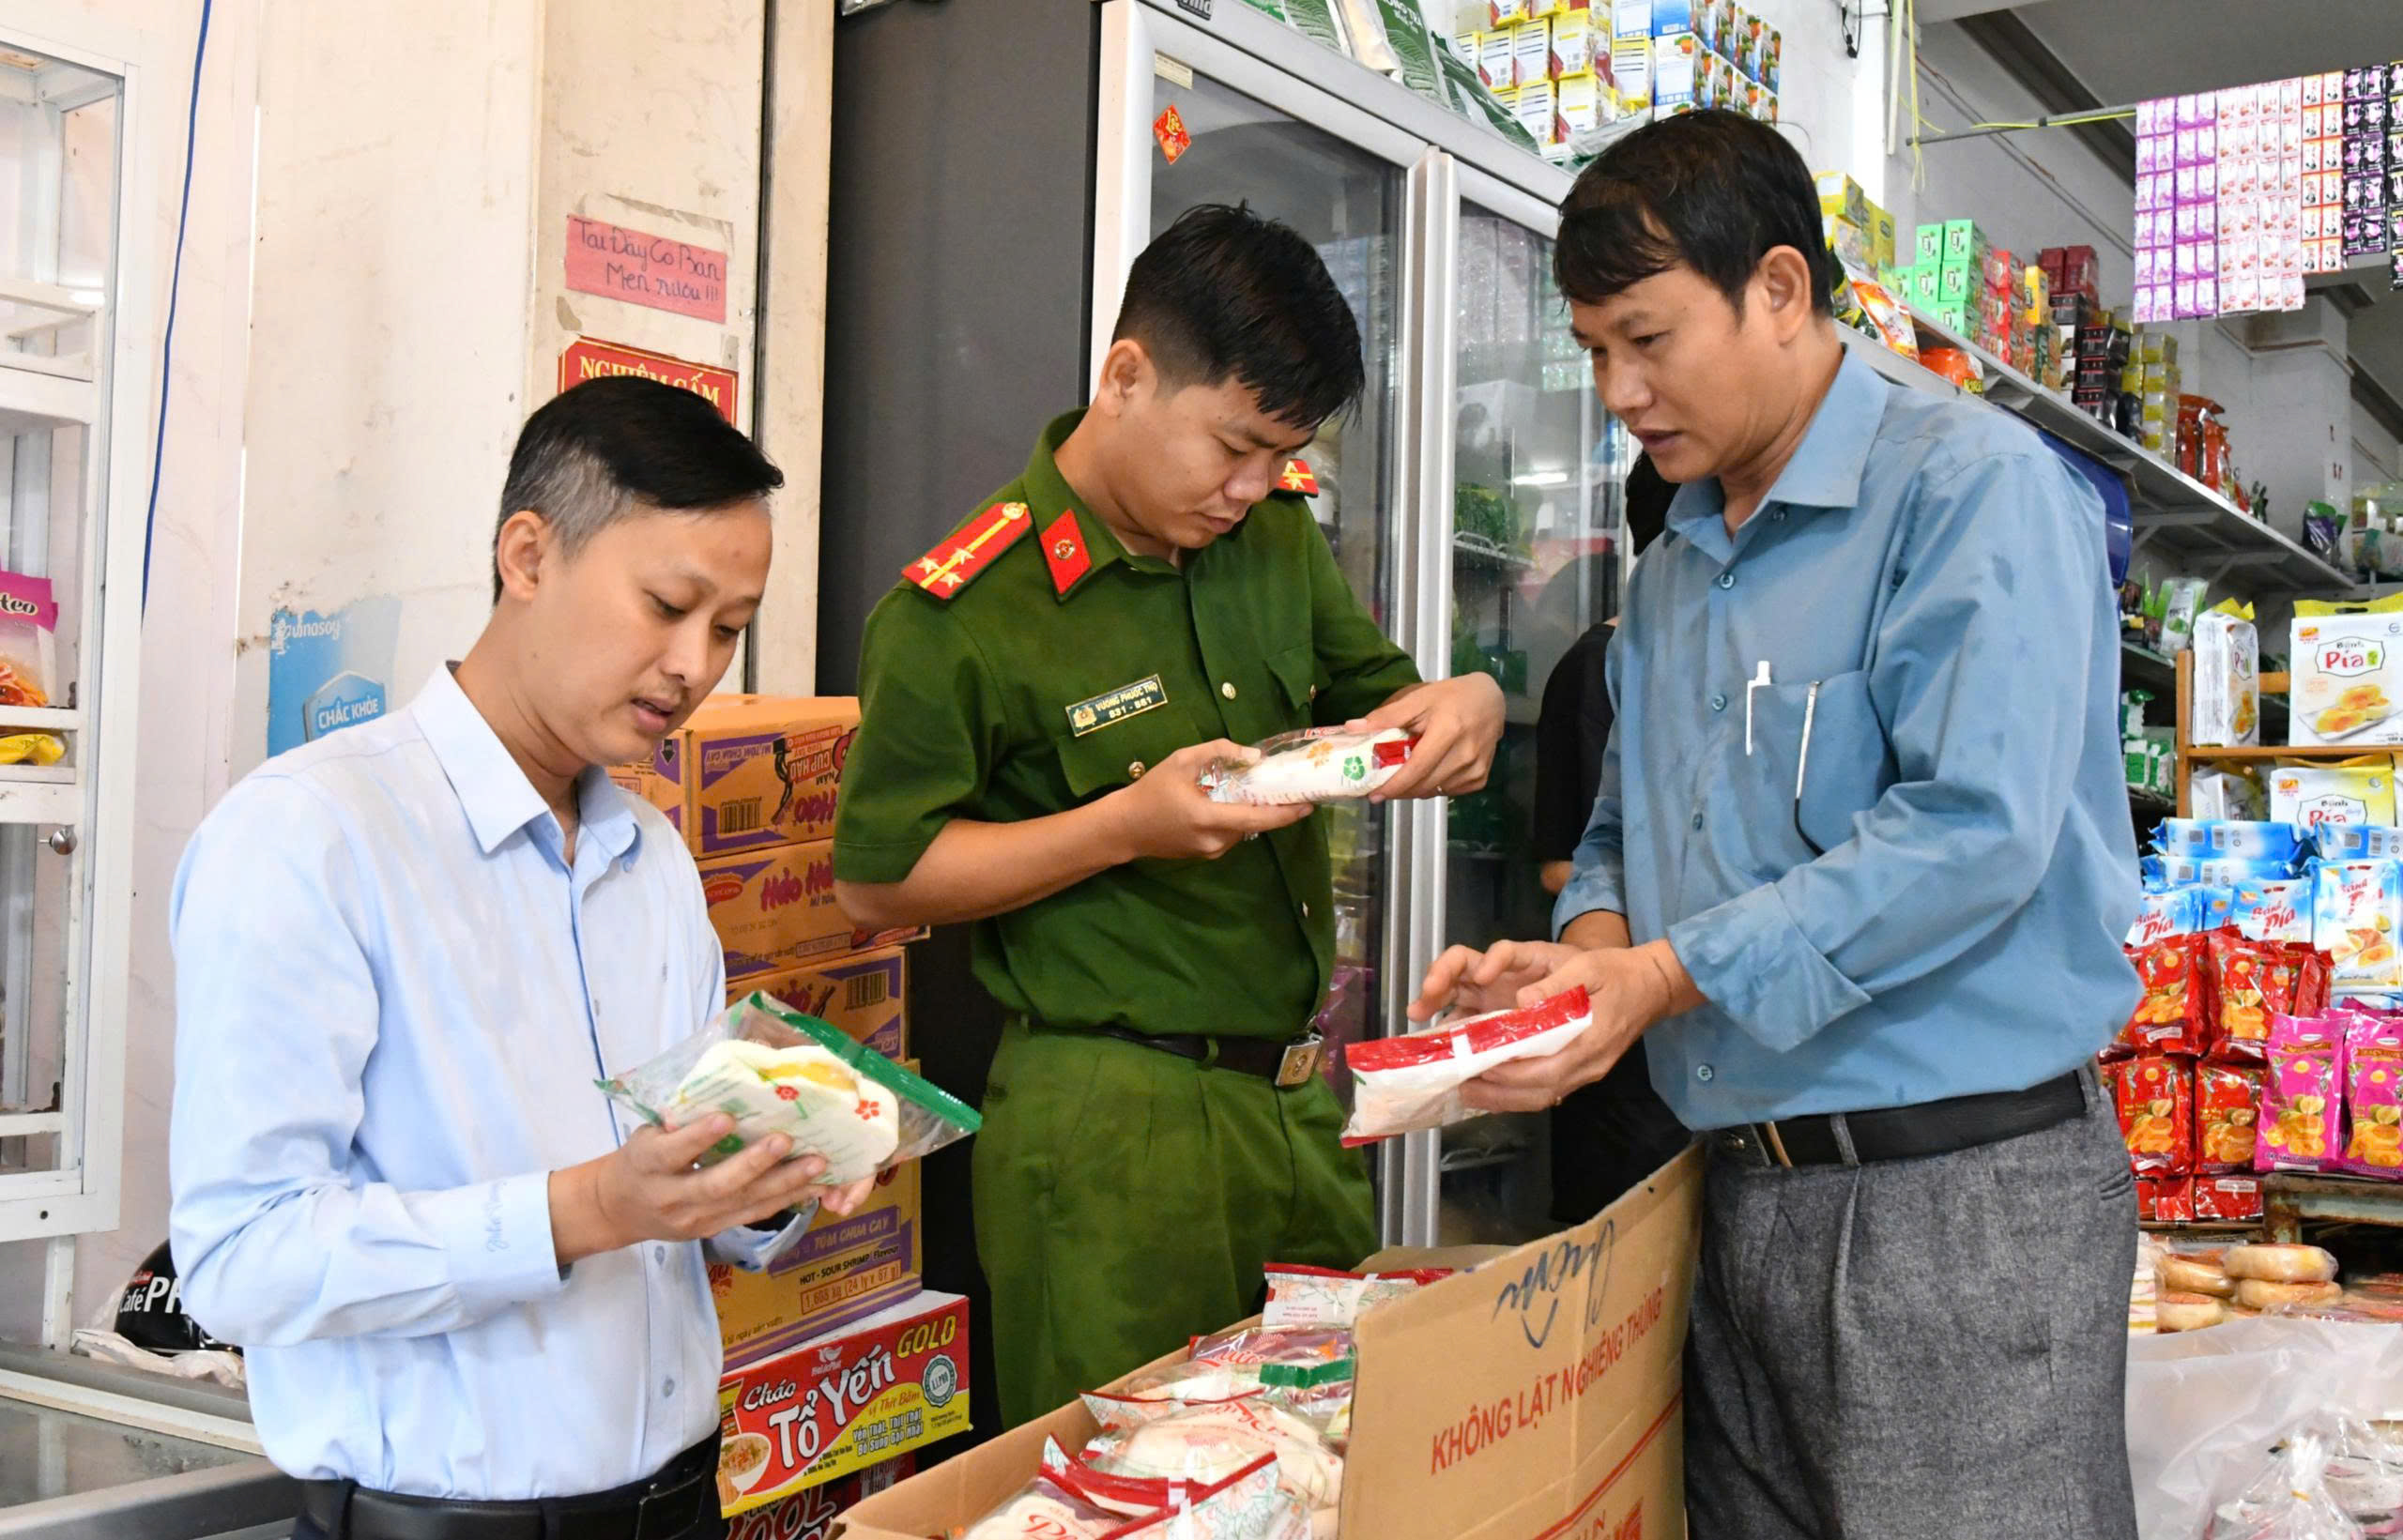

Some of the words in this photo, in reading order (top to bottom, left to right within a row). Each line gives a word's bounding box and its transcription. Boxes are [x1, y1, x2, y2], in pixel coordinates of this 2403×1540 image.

[607, 262, 650, 292] Men
[896, 1315, 957, 1358] GOLD
[743, 1379, 797, 1410] Cháo
[768, 1389, 820, 1469] Tổ
[819, 1344, 895, 1426] Yến
[1431, 1396, 1511, 1476] KHÔNG
